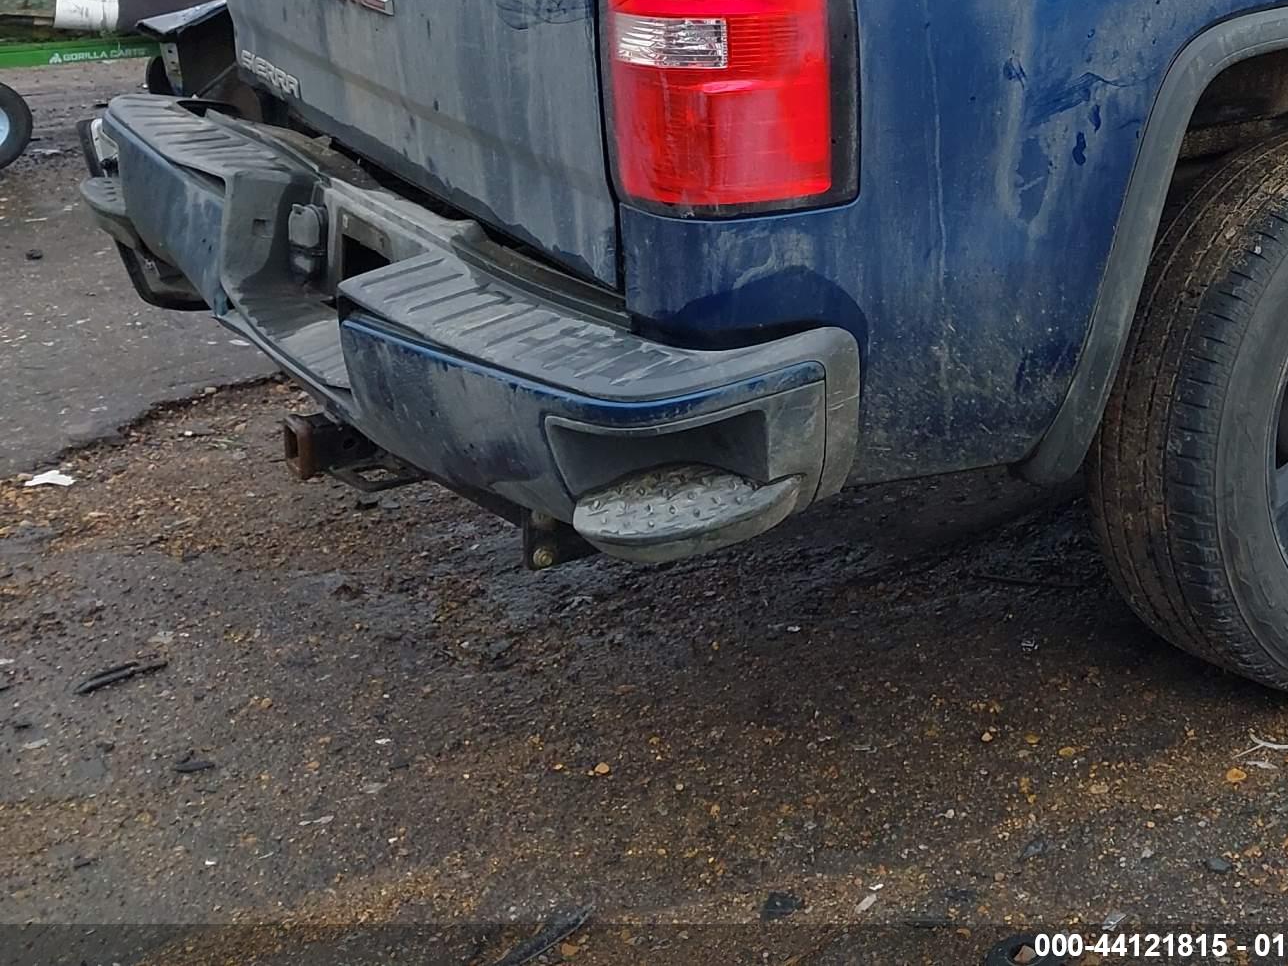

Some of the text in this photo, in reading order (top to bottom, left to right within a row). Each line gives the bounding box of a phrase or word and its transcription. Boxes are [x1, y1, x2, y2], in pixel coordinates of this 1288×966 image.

[62, 47, 147, 62] GORILLA CARTS
[240, 49, 300, 99] SIERRA
